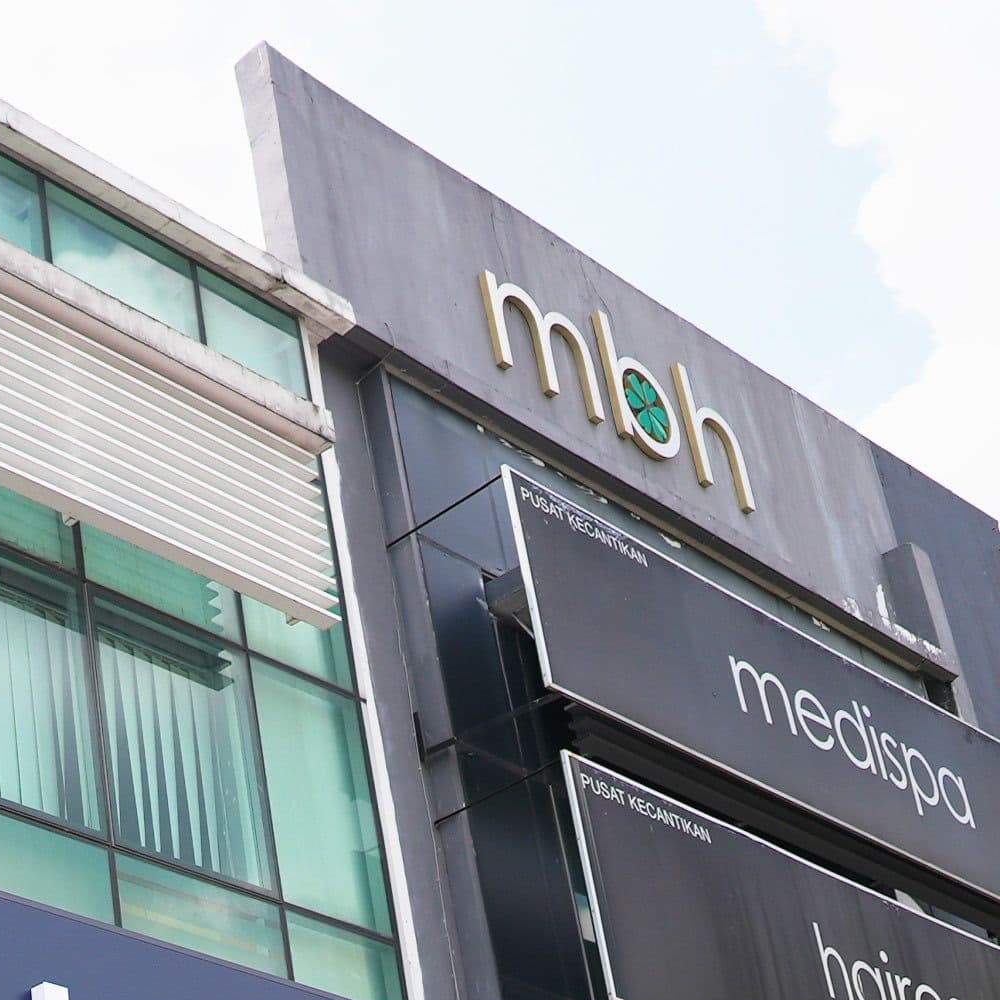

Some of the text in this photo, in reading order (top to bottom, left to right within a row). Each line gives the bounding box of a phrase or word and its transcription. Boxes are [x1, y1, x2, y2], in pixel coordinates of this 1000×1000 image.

[480, 270, 756, 514] mbh
[520, 487, 648, 567] PUSAT KECANTIKAN
[728, 654, 976, 830] medispa
[580, 773, 713, 845] PUSAT KECANTIKAN
